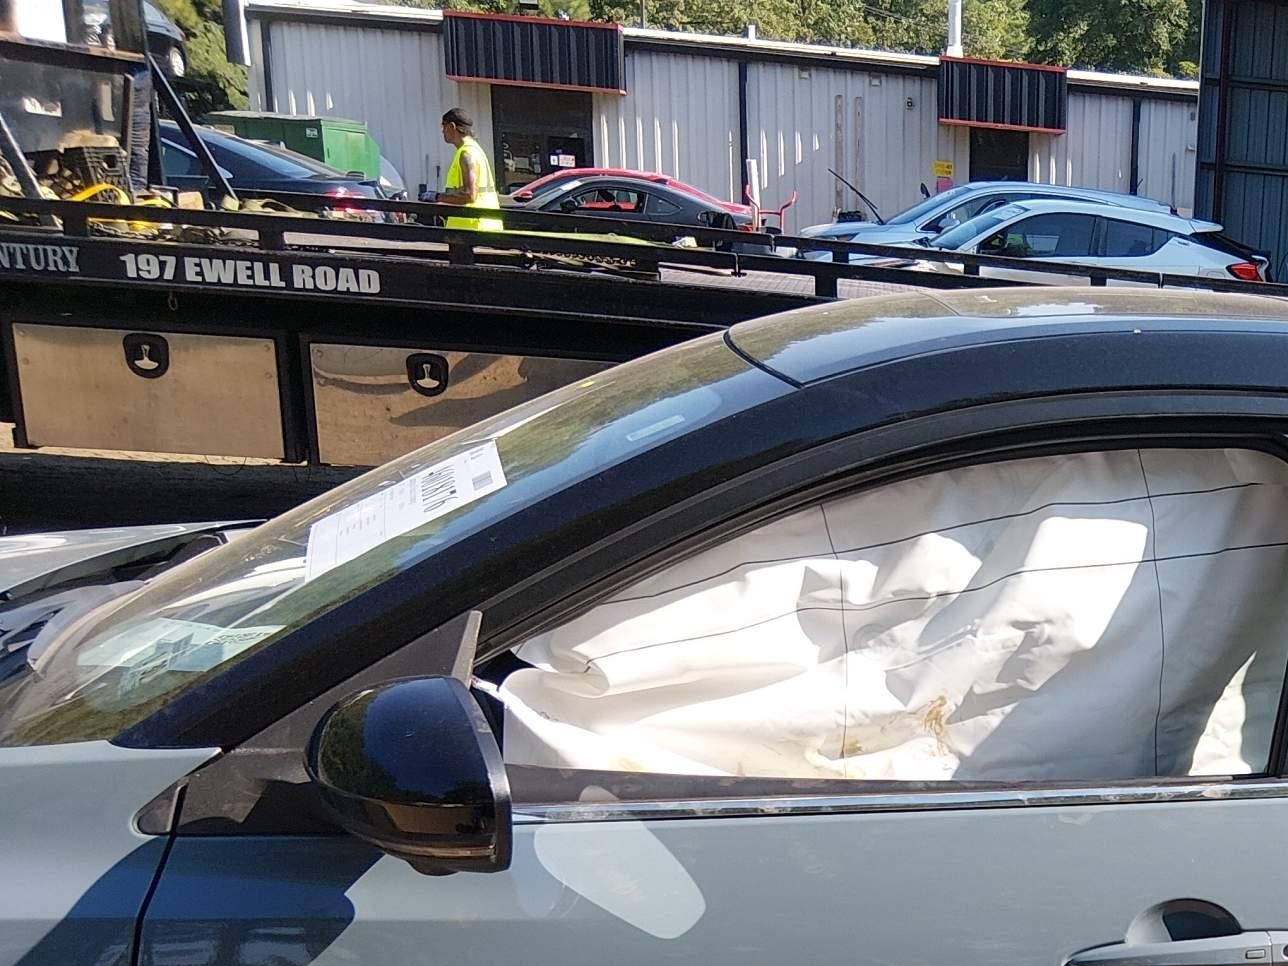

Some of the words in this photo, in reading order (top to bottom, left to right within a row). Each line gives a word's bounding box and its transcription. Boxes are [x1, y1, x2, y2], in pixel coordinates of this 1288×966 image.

[120, 253, 177, 280] 197
[184, 256, 286, 288] EWELL
[292, 264, 380, 294] ROAD
